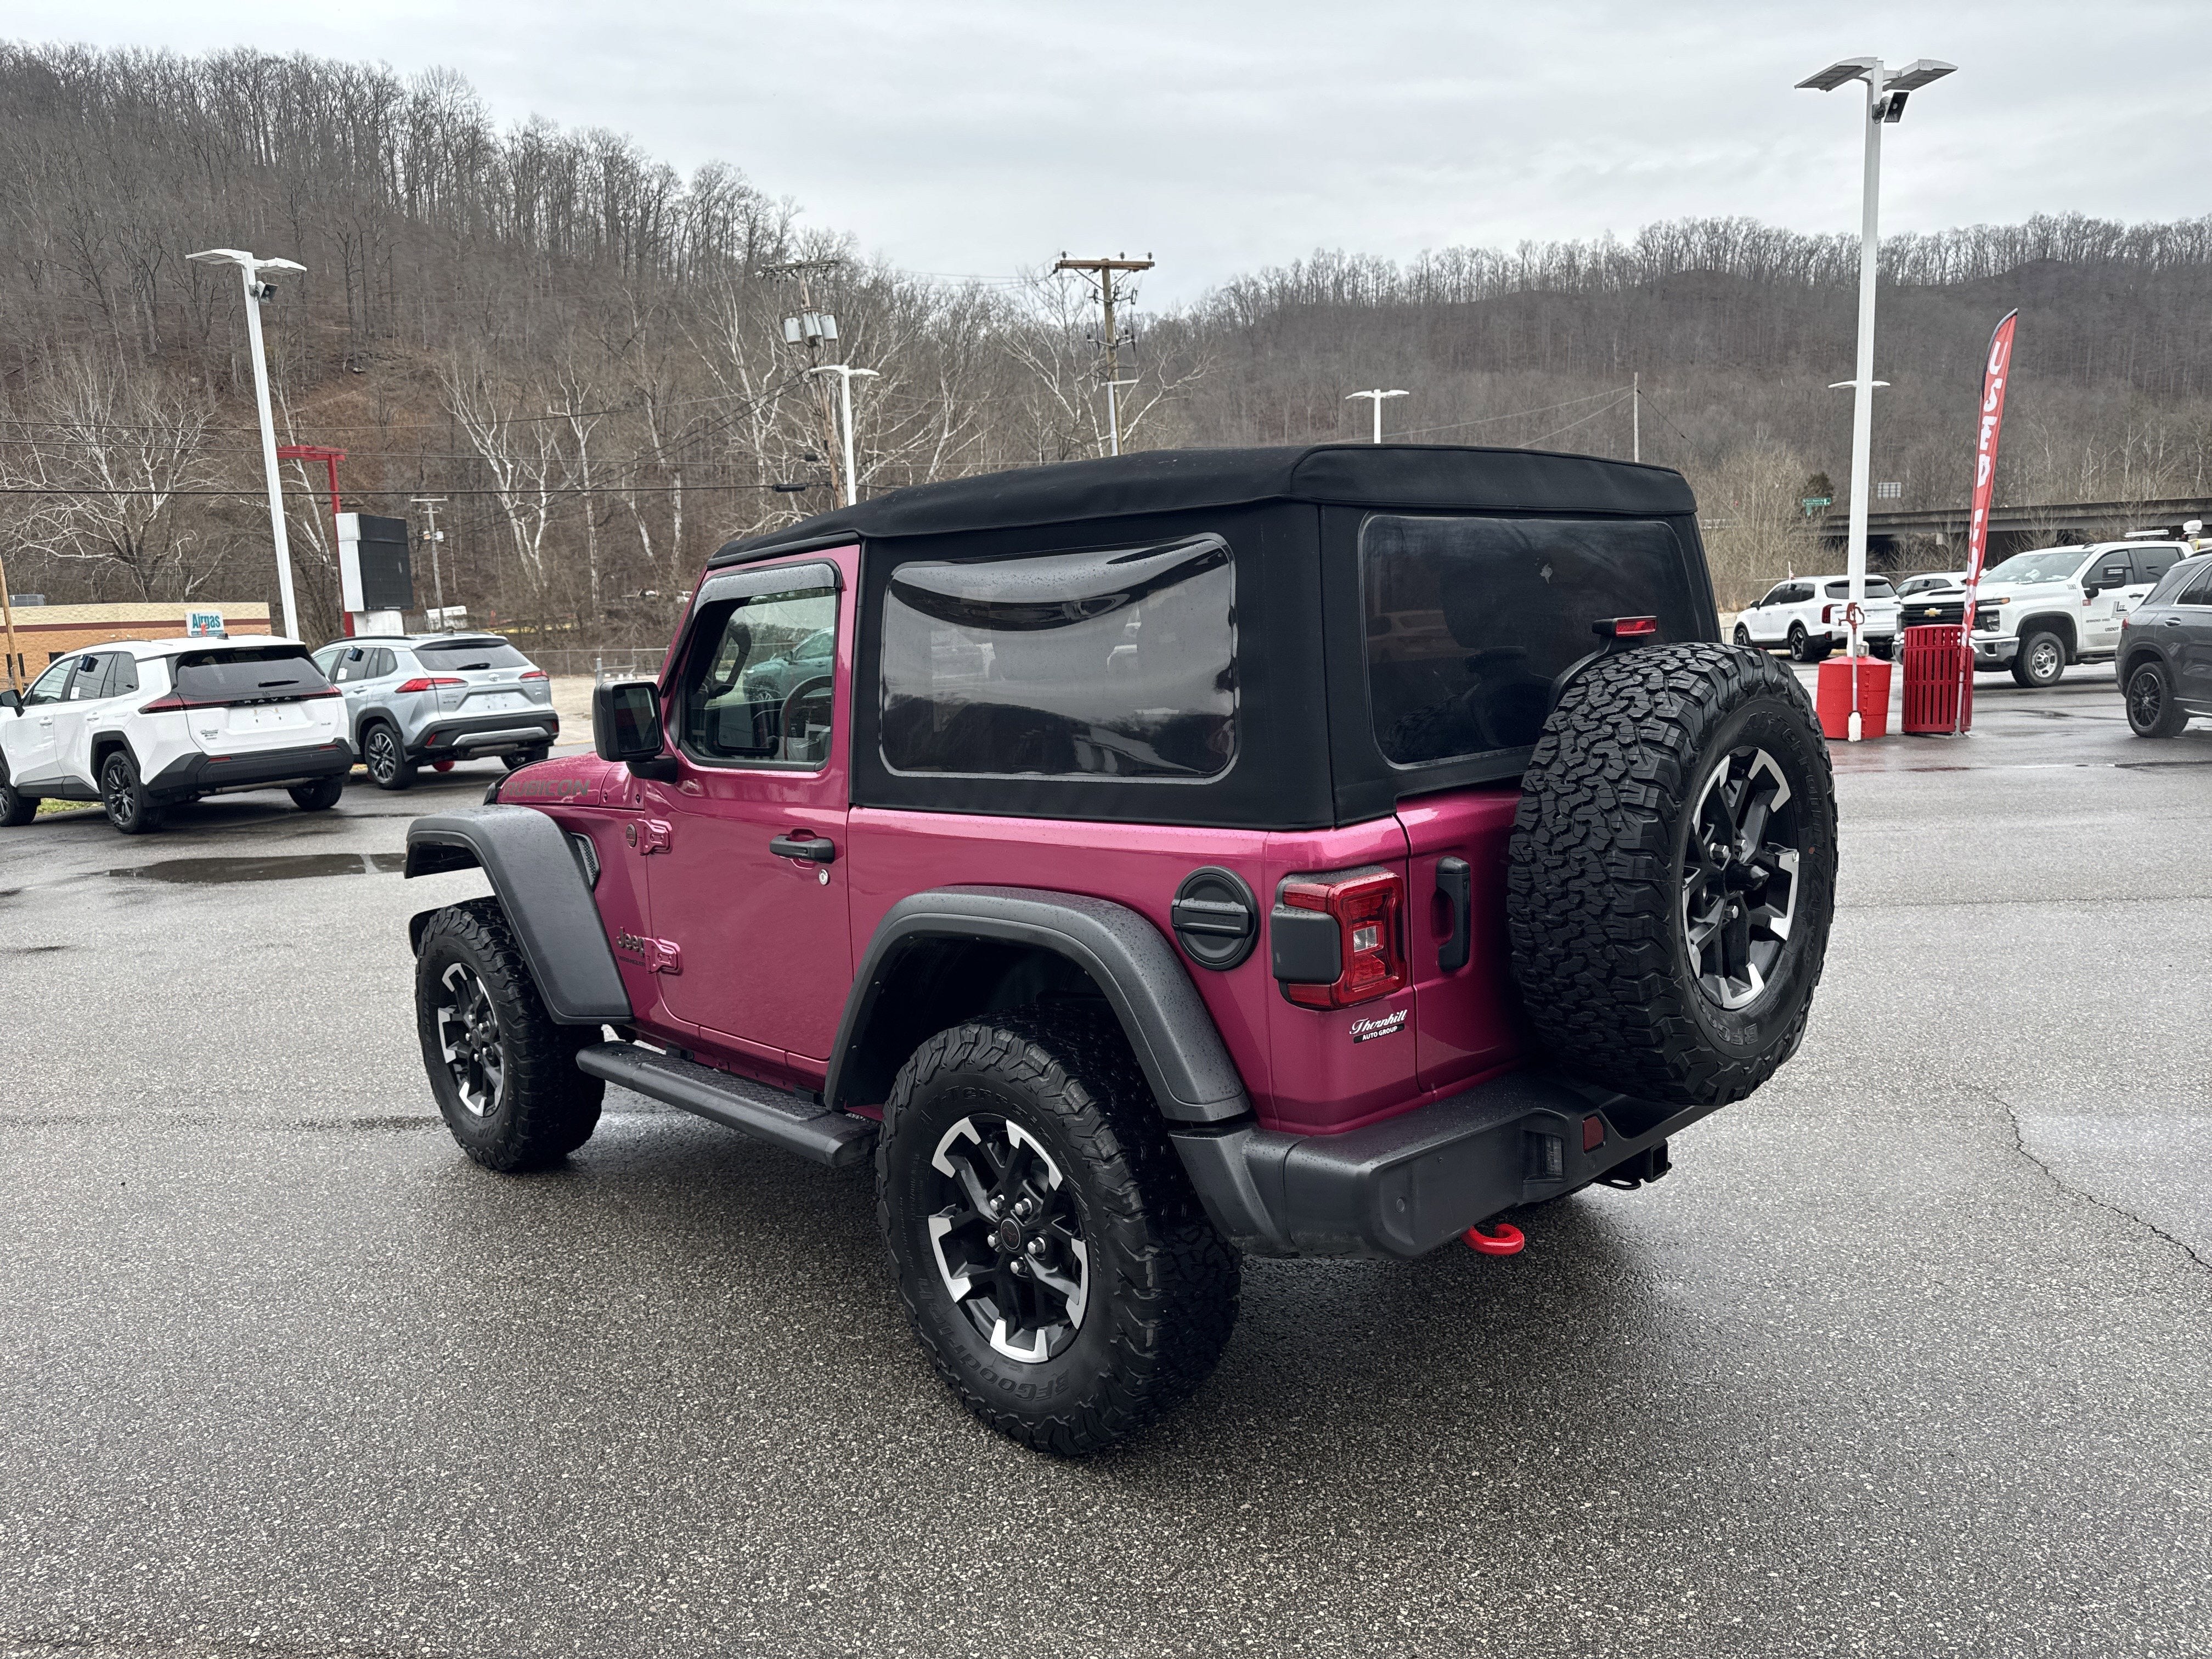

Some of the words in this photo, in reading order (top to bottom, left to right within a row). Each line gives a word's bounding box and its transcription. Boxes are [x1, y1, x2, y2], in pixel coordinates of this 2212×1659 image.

[1977, 341, 2008, 488] USED
[192, 613, 221, 629] Airgas
[503, 779, 590, 796] RUBICON
[616, 926, 645, 958] Jeep
[1350, 1009, 1407, 1035] Thornhill
[1362, 1032, 1378, 1041] AUTO
[1379, 1026, 1398, 1036] GROUP
[918, 1277, 1070, 1401] BFGoodrich
